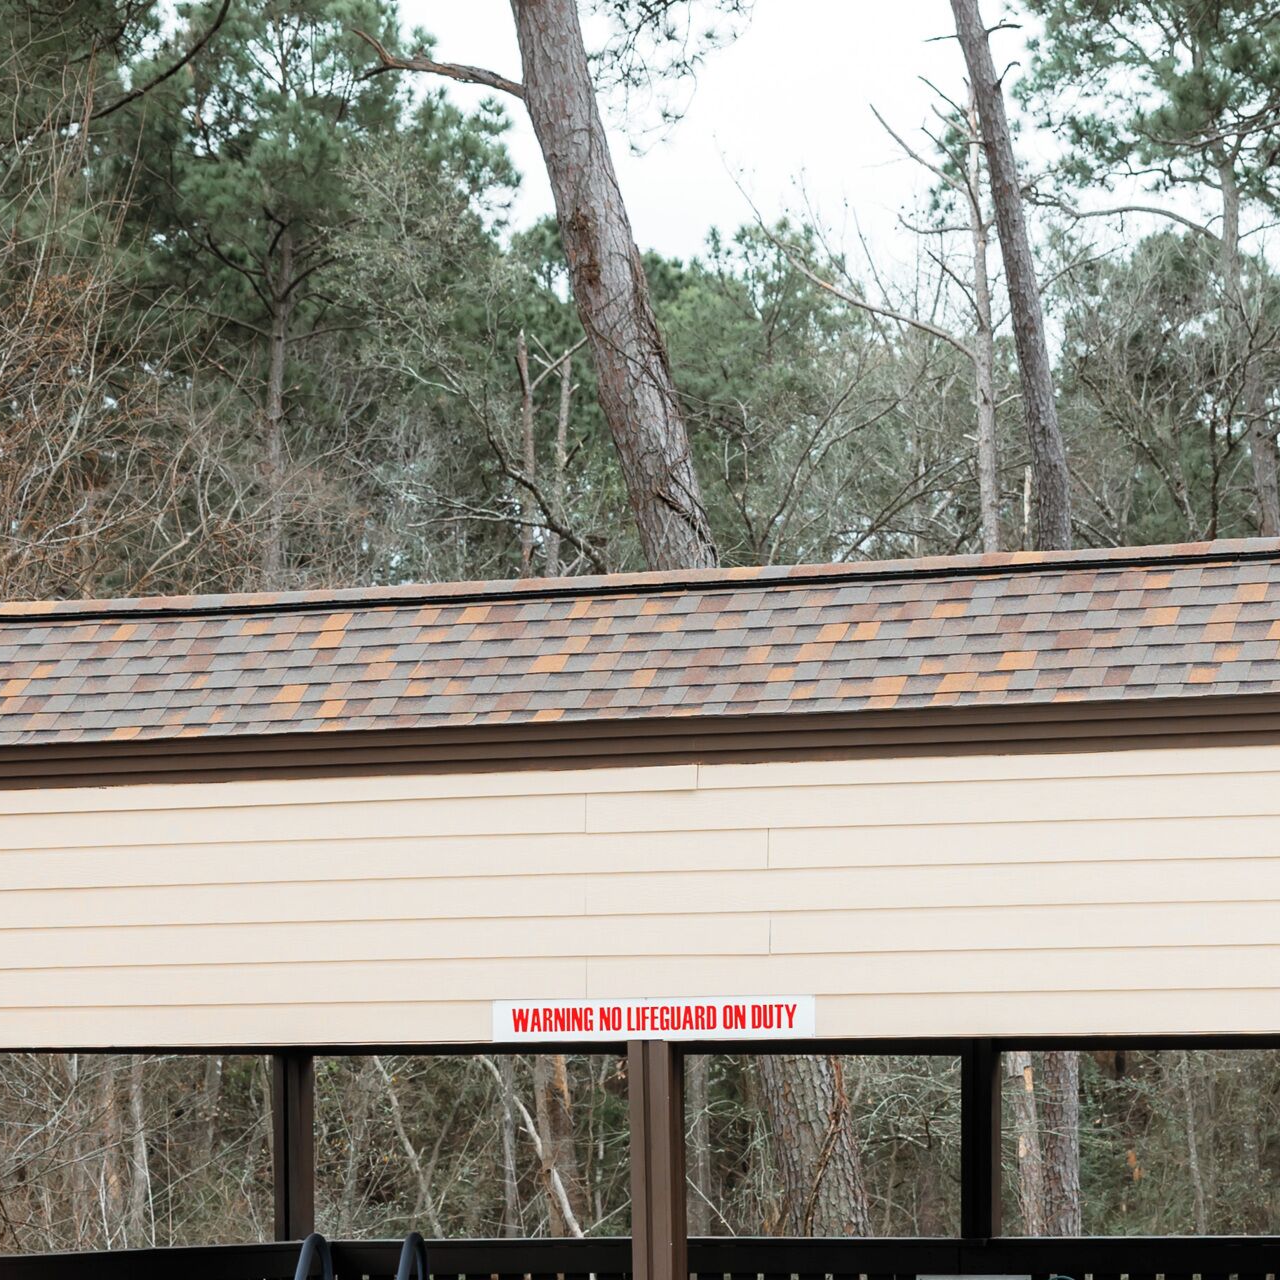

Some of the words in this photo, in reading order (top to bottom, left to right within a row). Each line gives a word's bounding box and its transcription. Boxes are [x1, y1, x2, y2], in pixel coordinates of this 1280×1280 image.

[512, 1007, 594, 1033] WARNING
[599, 1006, 622, 1031] NO
[627, 1005, 716, 1031] LIFEGUARD
[723, 1005, 747, 1030] ON
[751, 1004, 797, 1029] DUTY
